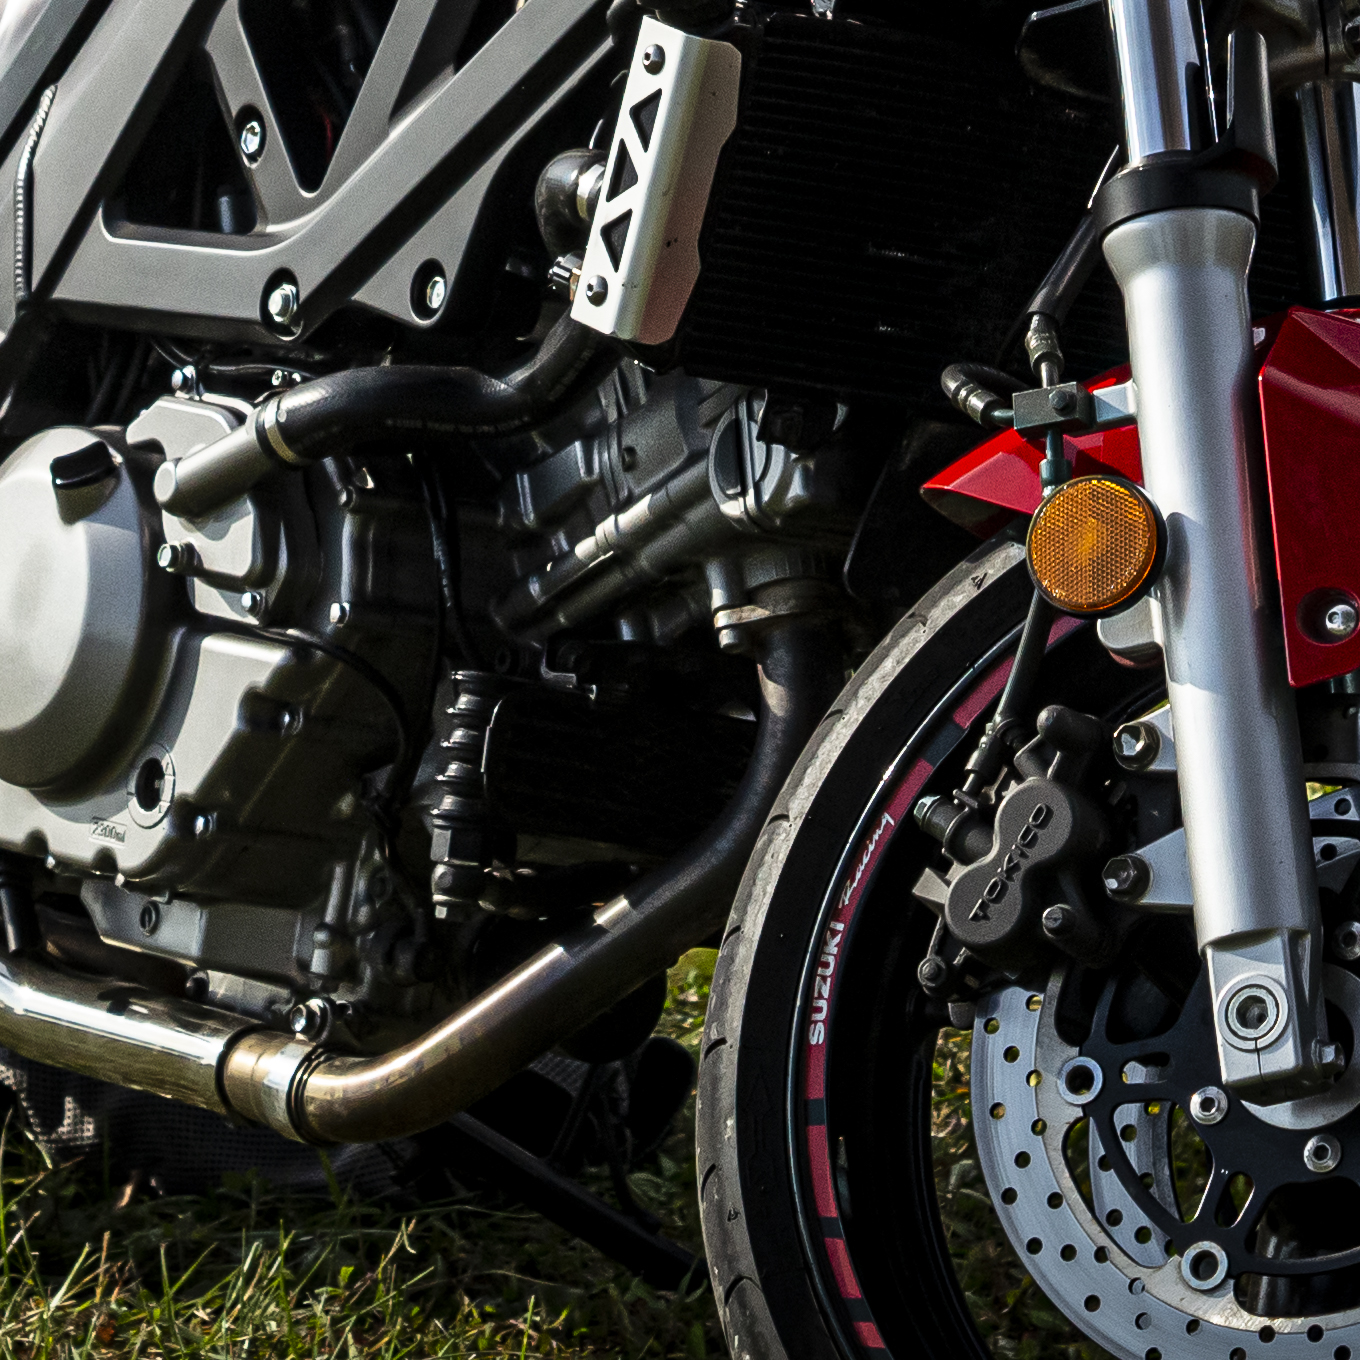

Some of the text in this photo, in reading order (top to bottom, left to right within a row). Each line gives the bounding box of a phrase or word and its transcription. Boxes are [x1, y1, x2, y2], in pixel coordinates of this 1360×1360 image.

[809, 812, 895, 1046] SUZUKI Racing
[968, 802, 1054, 923] TOKICO
